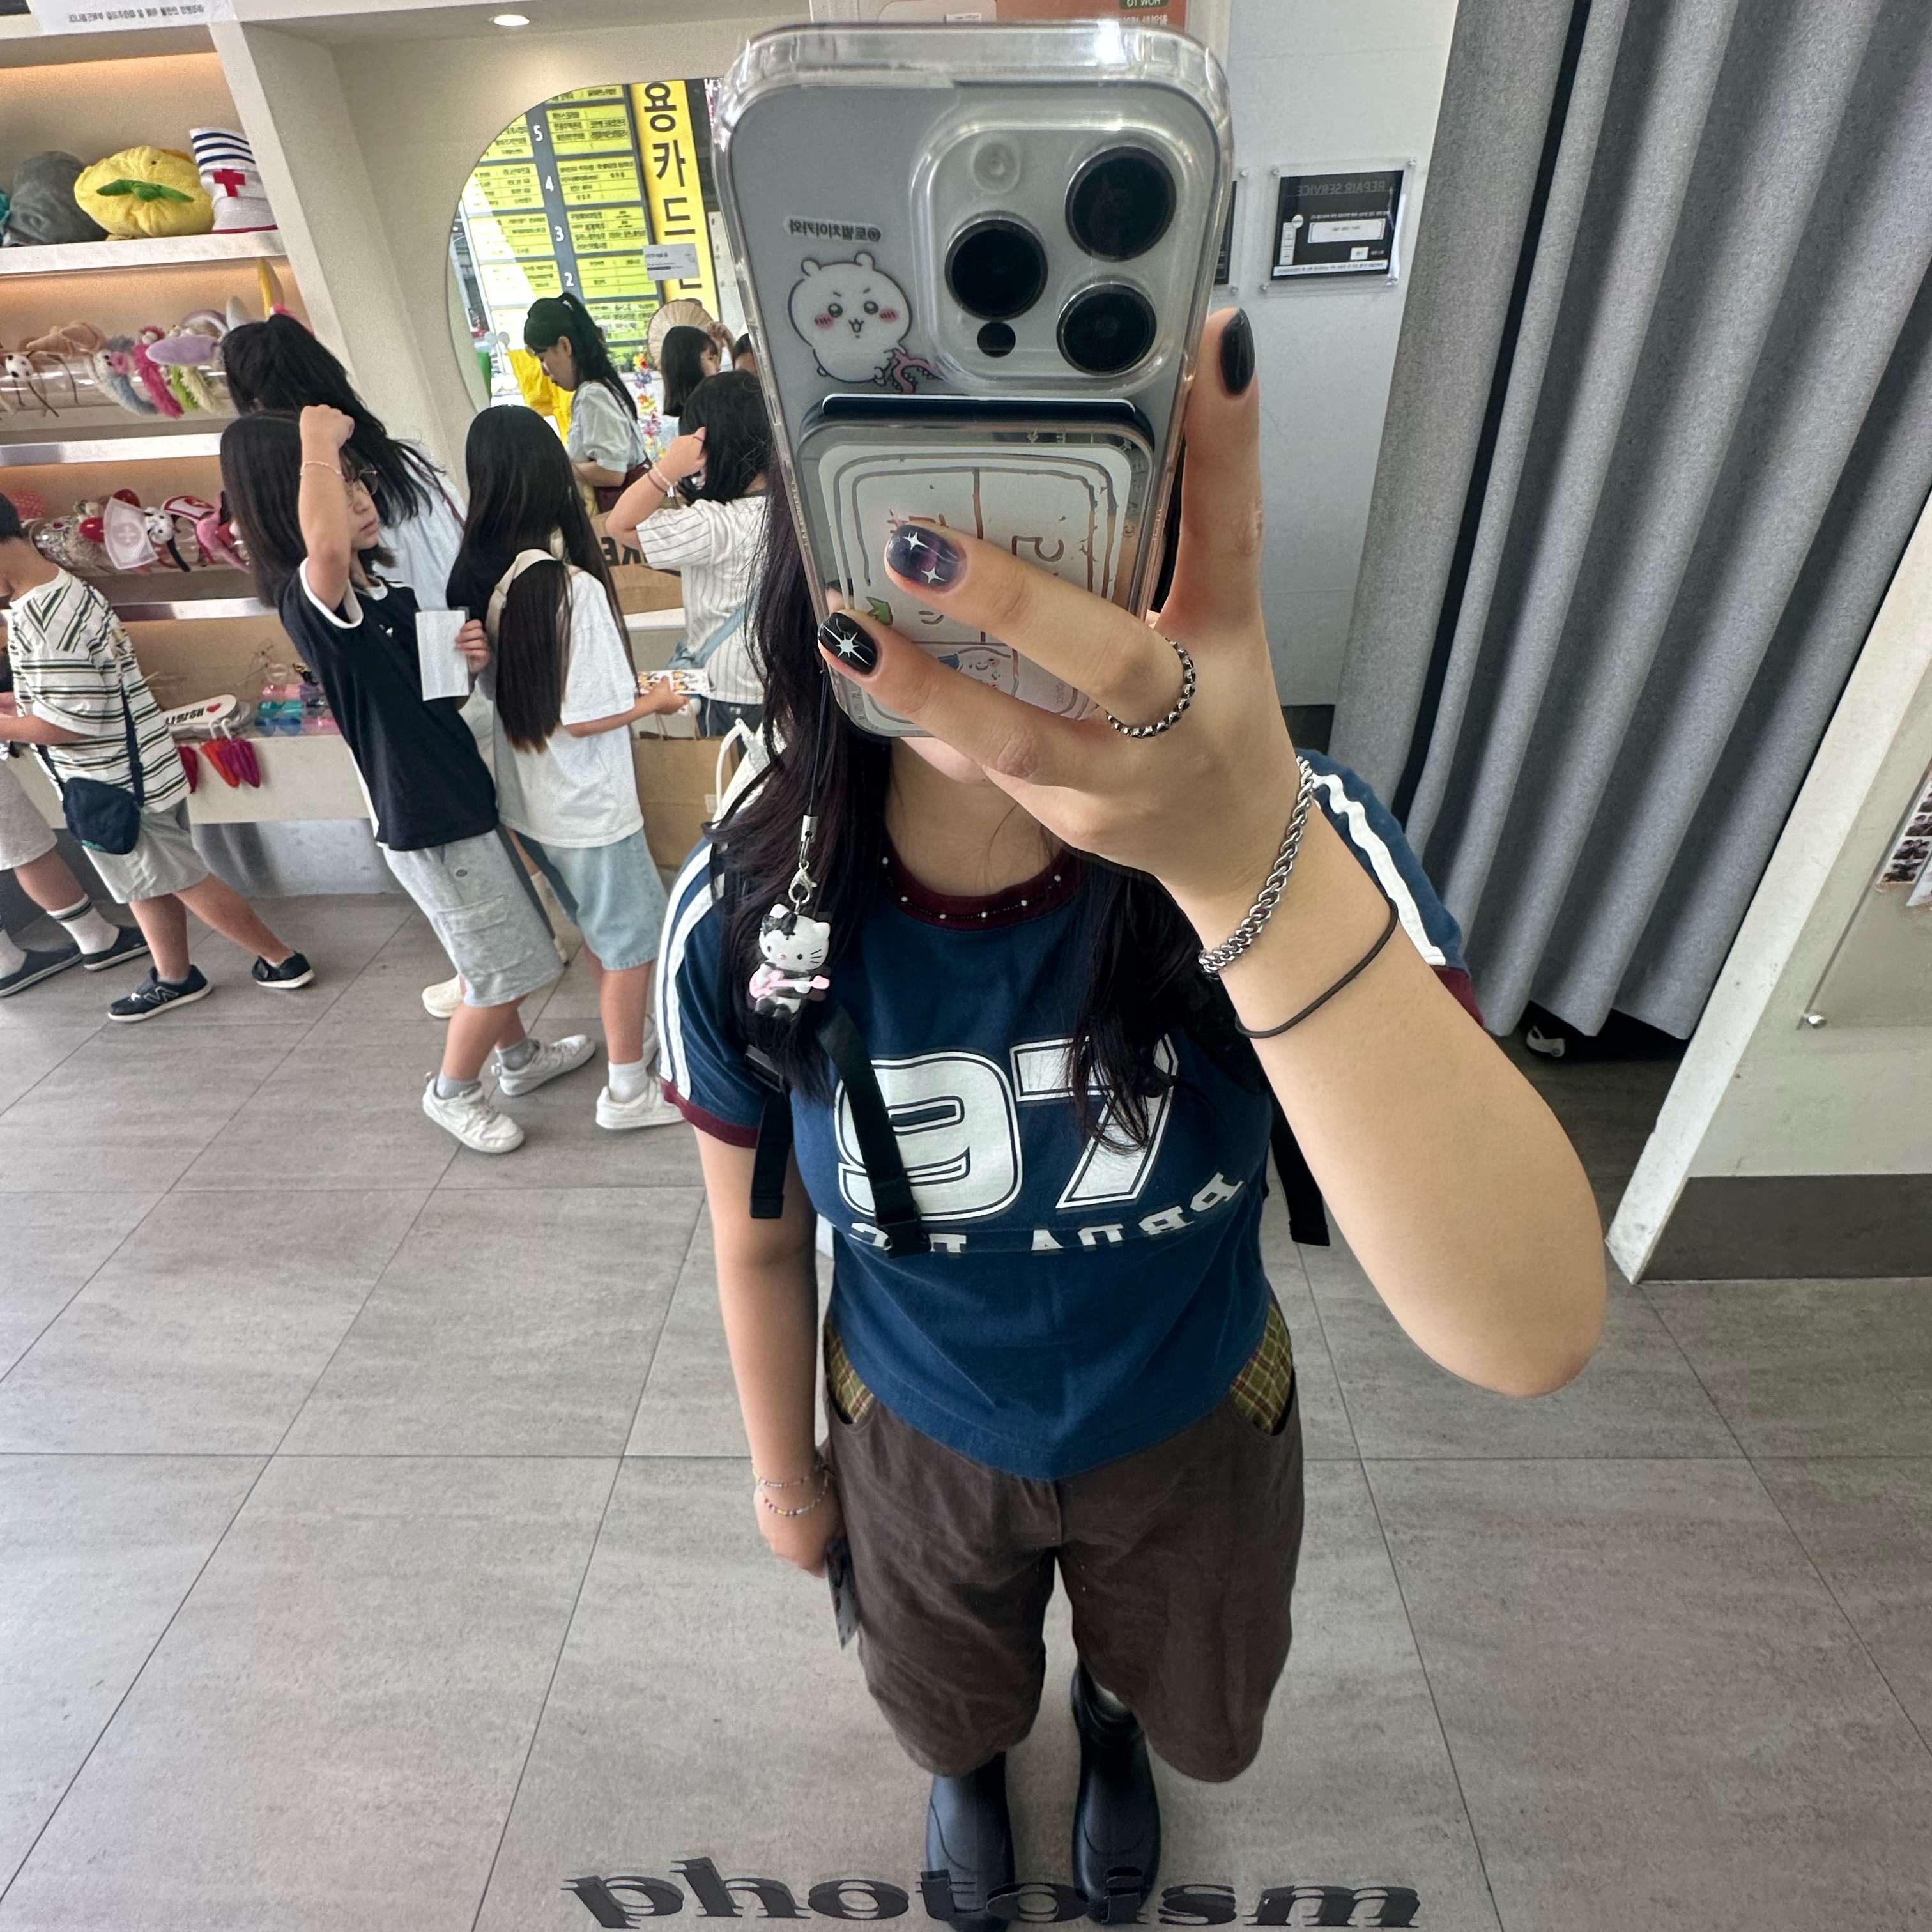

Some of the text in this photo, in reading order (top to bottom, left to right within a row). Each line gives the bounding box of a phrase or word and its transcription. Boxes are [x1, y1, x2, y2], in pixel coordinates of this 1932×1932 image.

[533, 125, 544, 142] 5
[545, 176, 555, 192] 4
[555, 226, 565, 242] 3
[564, 272, 574, 287] 2
[560, 1856, 1420, 1929] photoism
